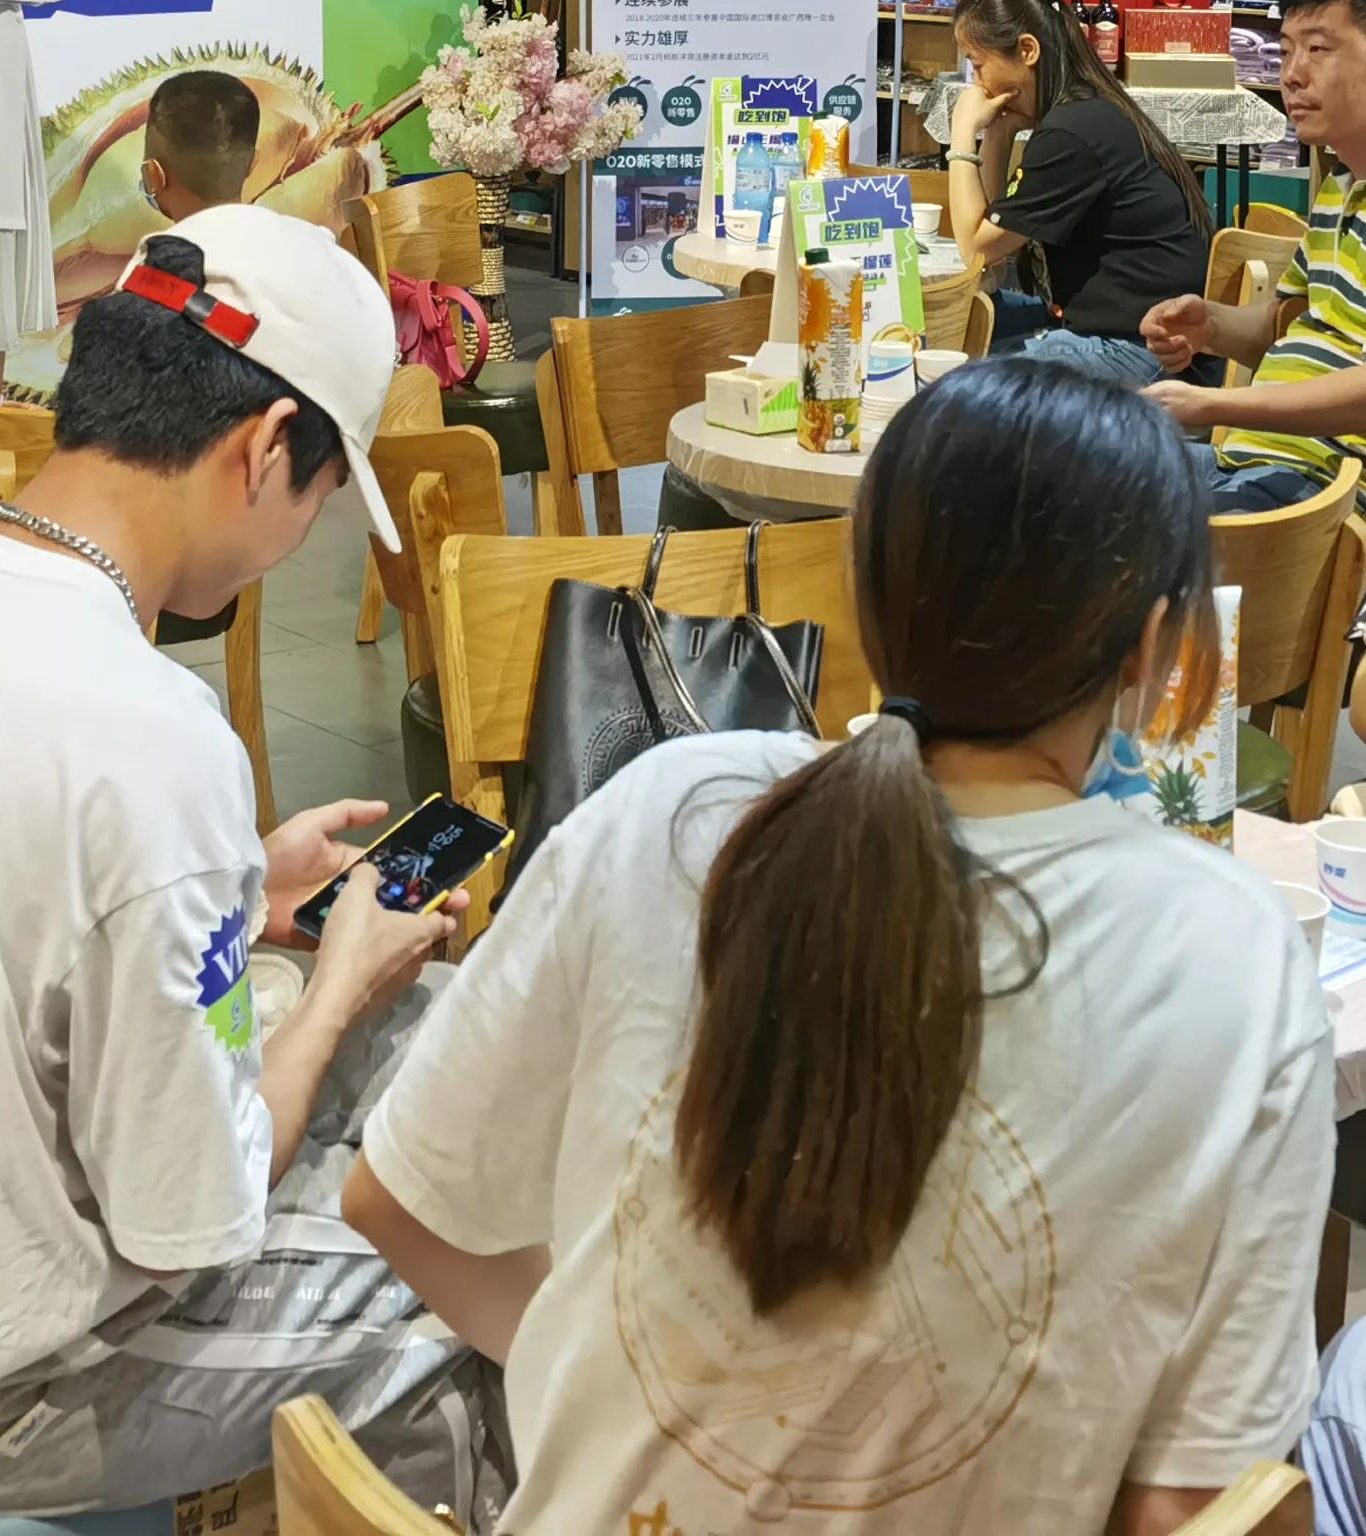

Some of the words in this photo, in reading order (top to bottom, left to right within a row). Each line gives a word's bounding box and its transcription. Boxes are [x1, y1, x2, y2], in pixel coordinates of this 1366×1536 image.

[625, 30, 690, 47] 实力雄厚
[668, 107, 696, 118] 新零售
[737, 110, 788, 123] 吃到饱
[825, 222, 880, 242] 吃到饱
